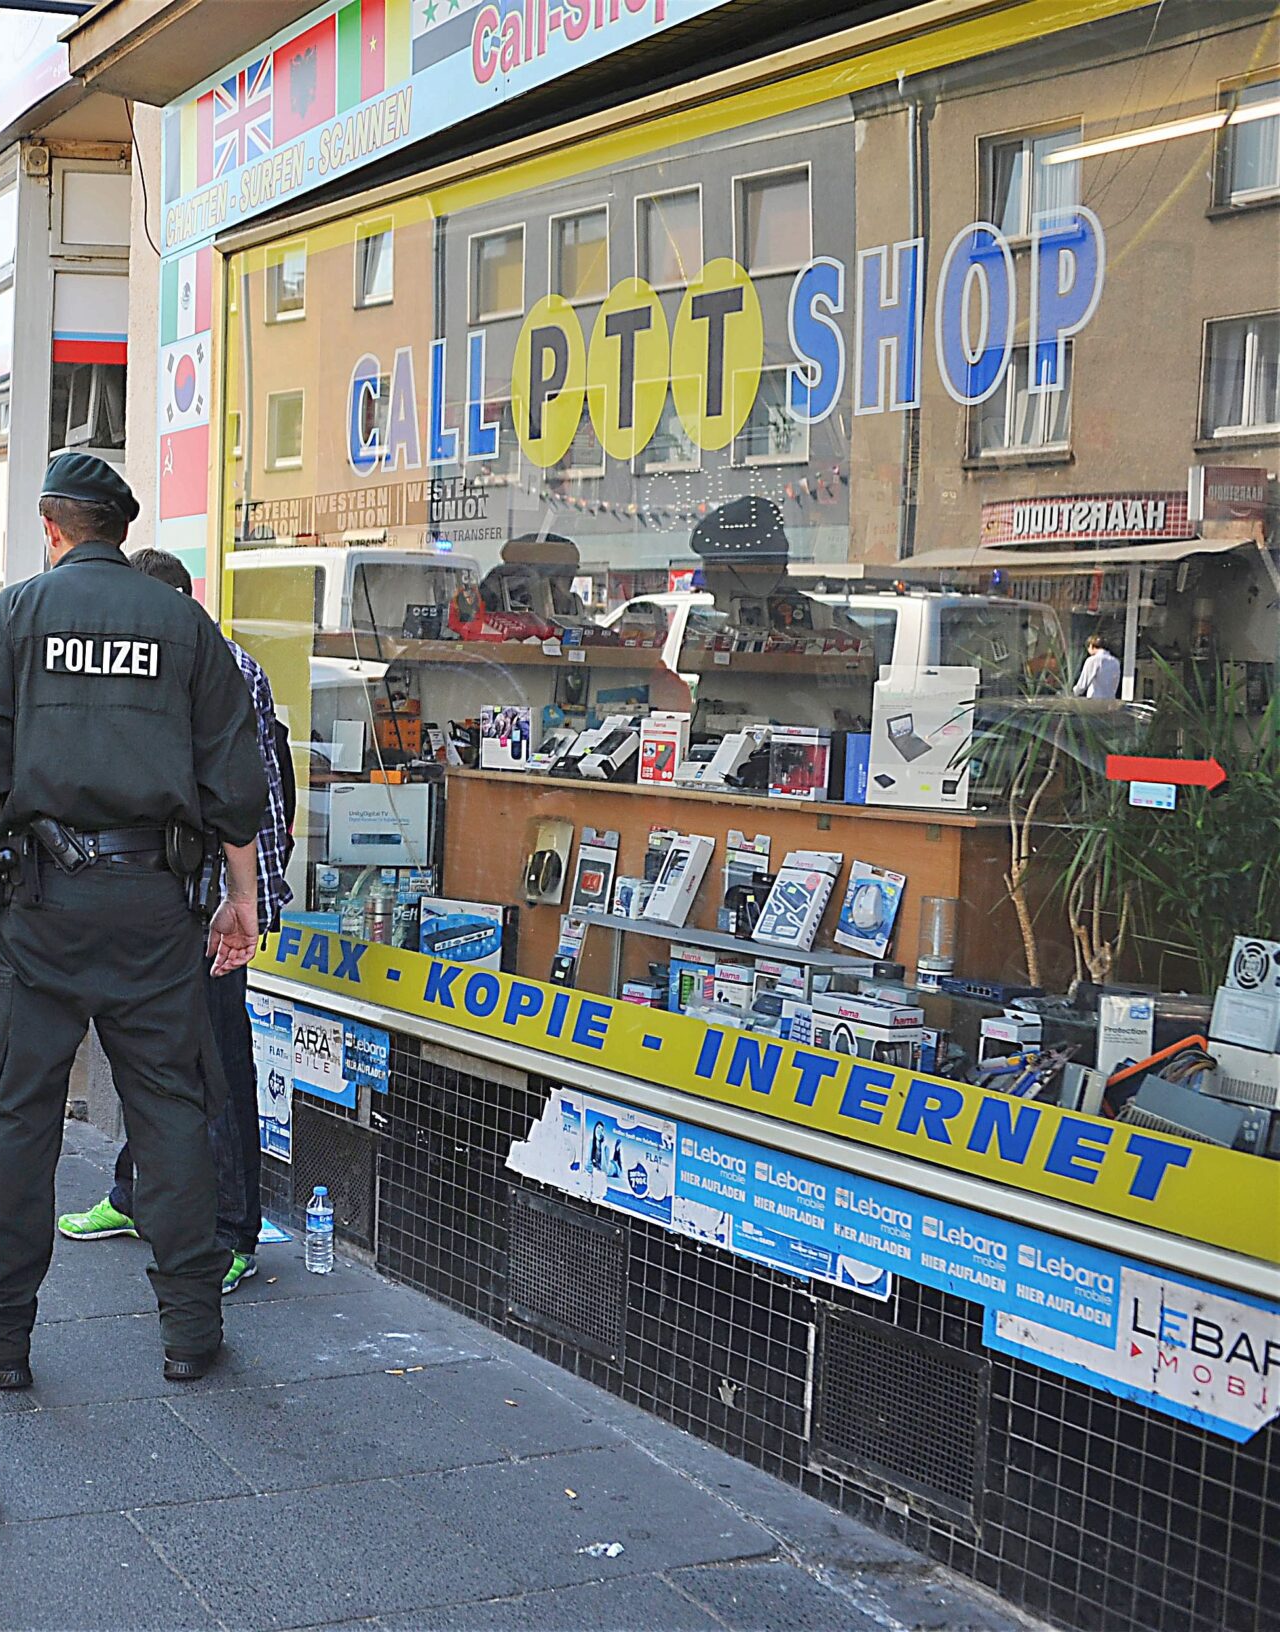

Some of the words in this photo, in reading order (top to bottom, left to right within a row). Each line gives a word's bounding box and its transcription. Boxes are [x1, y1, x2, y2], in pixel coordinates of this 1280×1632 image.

[472, 0, 665, 84] Call-S
[166, 181, 228, 248] CHATTEN
[240, 141, 305, 213] SURFEN
[319, 86, 412, 175] SCANNEN
[346, 329, 501, 477] CALL
[530, 286, 745, 441] PTT
[785, 205, 1106, 425] SHOP
[235, 500, 299, 522] WESTERN
[316, 485, 388, 514] WESTERN
[432, 497, 488, 522] UNION
[255, 518, 299, 539] UNION
[337, 507, 388, 531] UNION
[454, 527, 502, 541] TRANSFER
[412, 607, 437, 617] OCB
[45, 637, 158, 677] POLIZEI
[681, 951, 701, 961] hama
[720, 969, 740, 980] hama
[759, 963, 781, 973] hama
[627, 988, 644, 997] hama
[838, 1006, 860, 1019] hama
[893, 1015, 918, 1025] hama
[985, 1026, 1009, 1039] hama
[1104, 1025, 1148, 1035] Protection
[269, 1045, 284, 1057] FLAT
[353, 1034, 387, 1059] Lebara
[276, 926, 368, 983] FAX
[423, 962, 616, 1052] KOPIE
[695, 1029, 1192, 1201] INTERNET
[646, 1152, 662, 1165] FLAT
[694, 1140, 747, 1174] Lebara
[681, 1170, 701, 1188] HIER
[701, 1176, 746, 1202] AUFLADEN
[720, 1170, 745, 1184] mobile
[769, 1163, 826, 1200] Lebara
[754, 1195, 775, 1213] HIER
[778, 1202, 824, 1230] AUFLADEN
[797, 1195, 825, 1211] mobile
[850, 1189, 912, 1230] Lebara
[834, 1222, 857, 1242] HIER
[859, 1230, 911, 1260] AUFLADEN
[881, 1223, 911, 1241] mobile
[938, 1219, 1007, 1261] Lebara
[921, 1252, 946, 1273] HIER
[948, 1262, 1006, 1294] AUFLADEN
[972, 1253, 1006, 1272] mobile
[1036, 1249, 1114, 1294] Lebara
[1016, 1283, 1044, 1306] HIER
[1046, 1293, 1111, 1328] AUFLADEN
[1074, 1286, 1112, 1306] mobile
